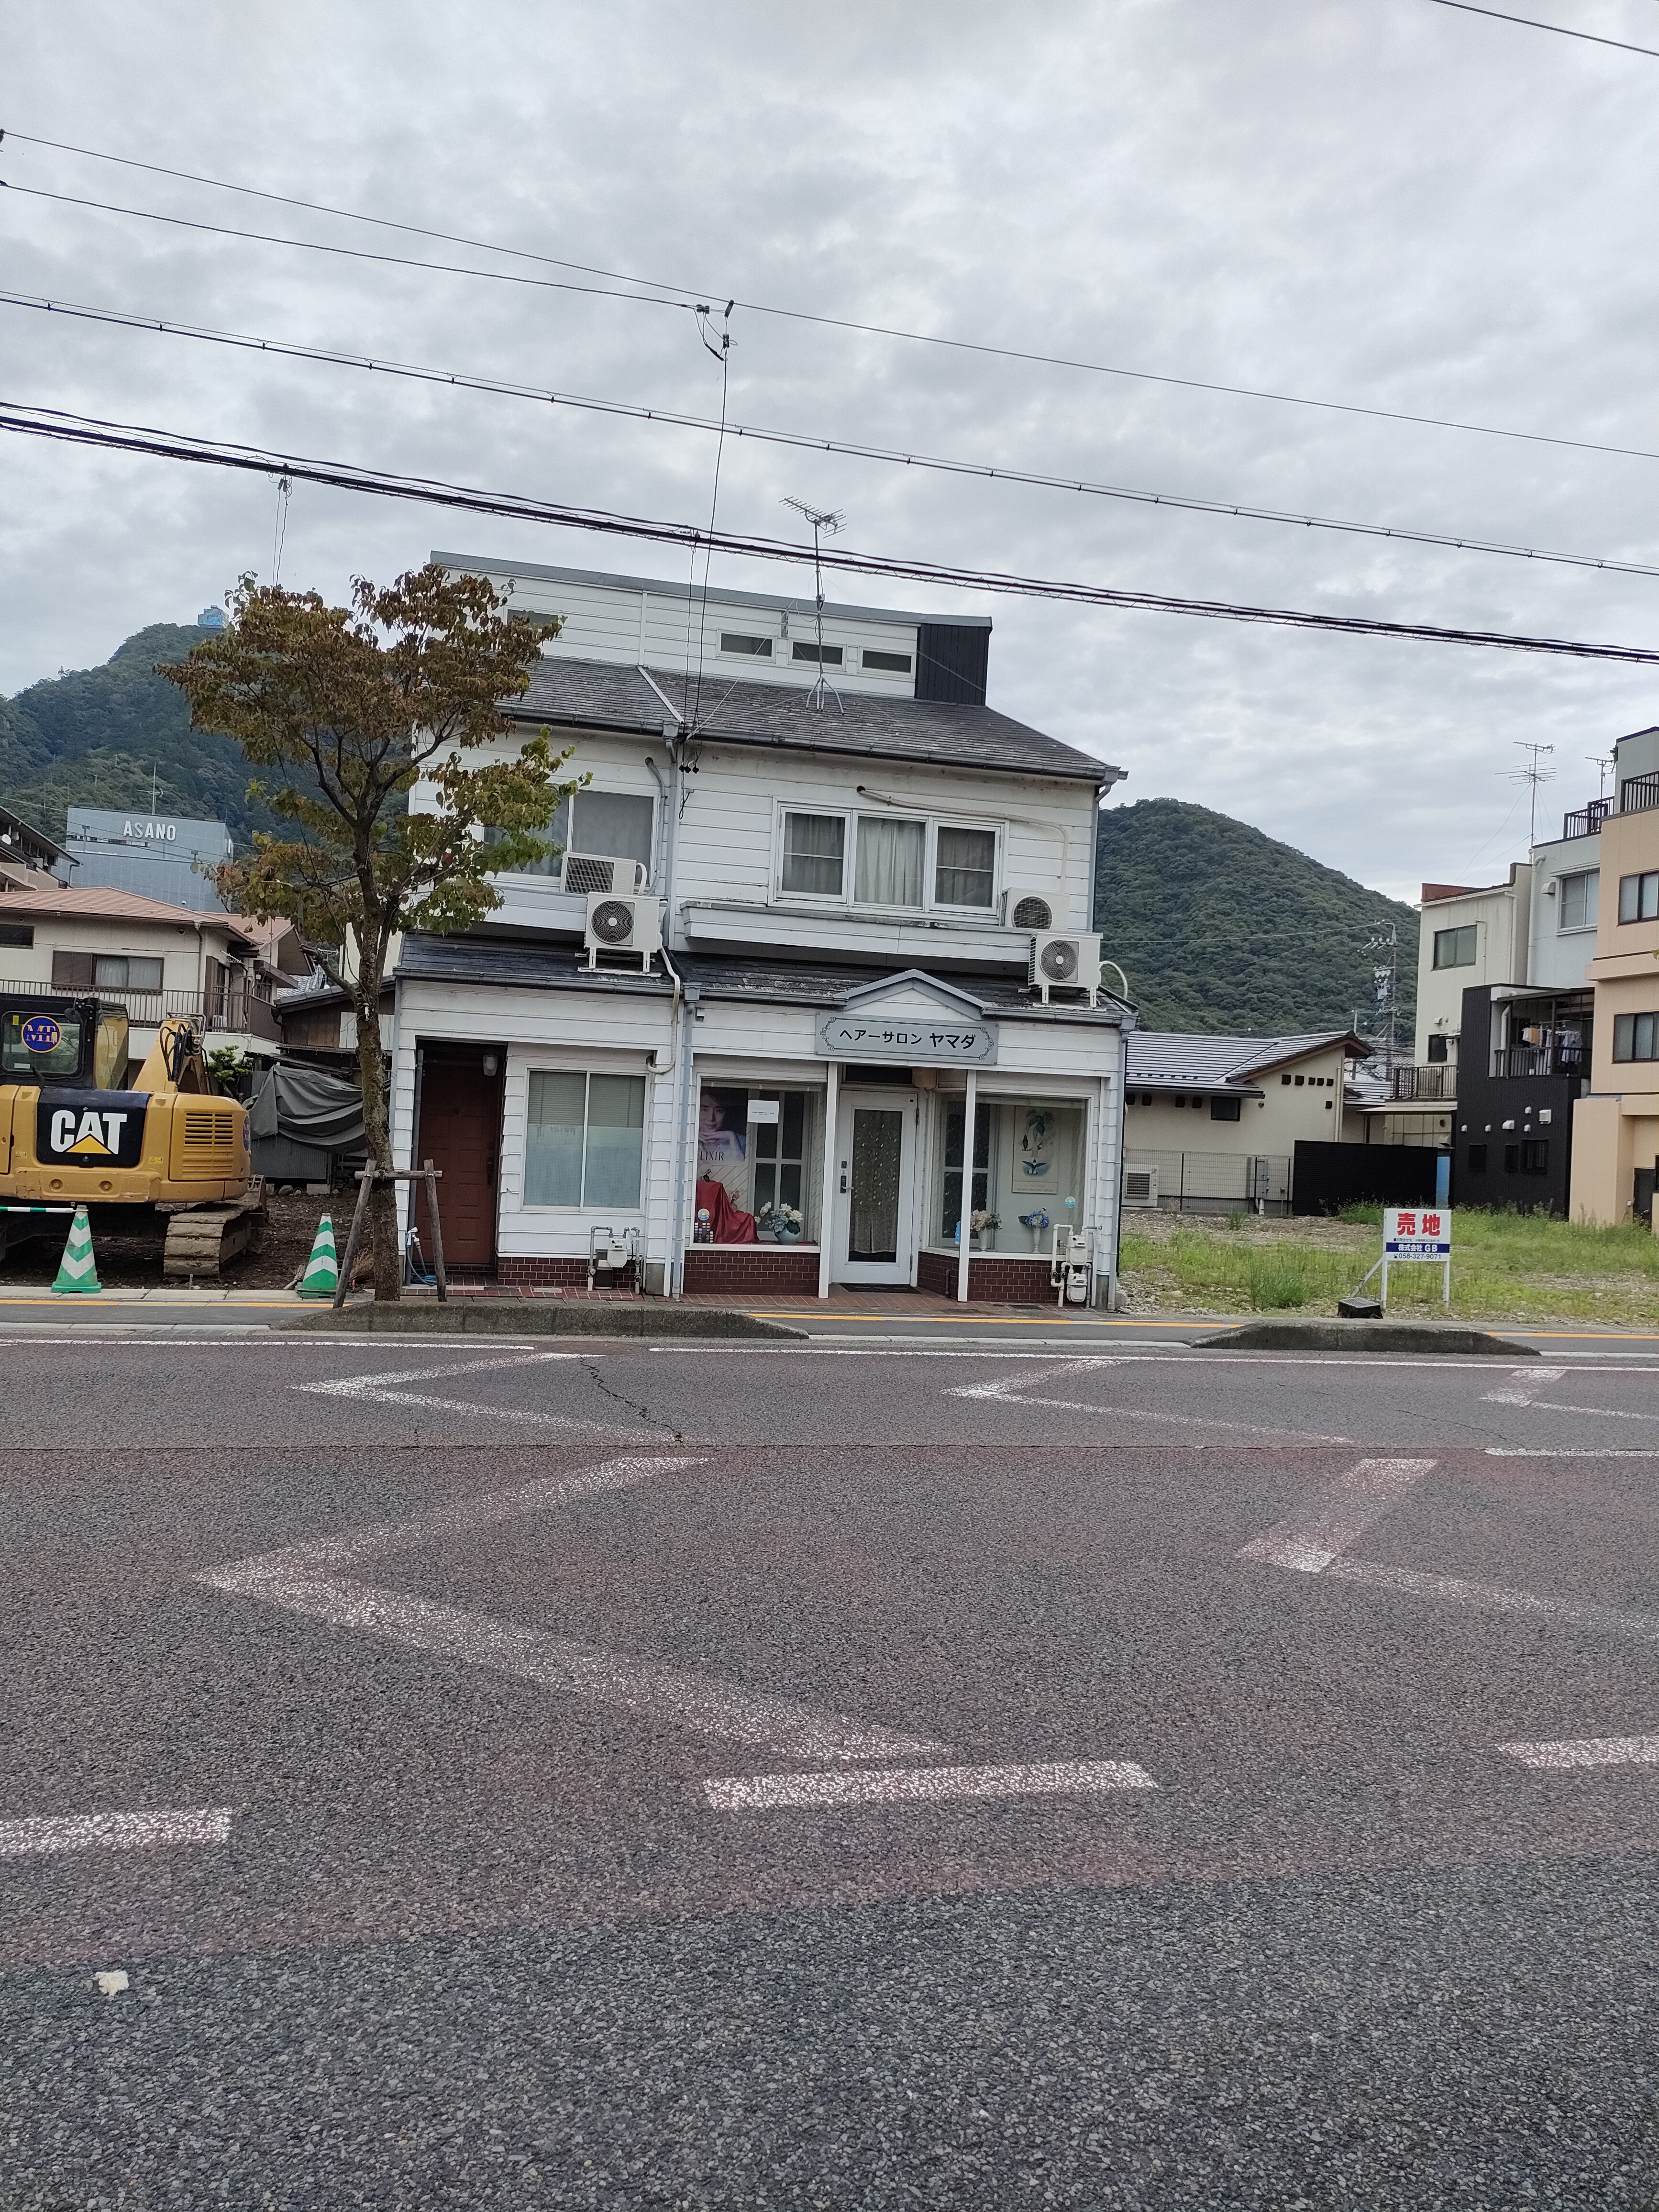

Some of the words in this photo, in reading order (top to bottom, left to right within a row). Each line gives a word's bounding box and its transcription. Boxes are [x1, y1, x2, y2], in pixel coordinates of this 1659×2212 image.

[123, 821, 176, 841] ASANO
[840, 1029, 922, 1045] ヘアーサロン
[929, 1032, 976, 1050] ヤマダ
[51, 1110, 127, 1154] CAT
[1397, 1213, 1440, 1236] 売地
[1398, 1244, 1423, 1252] 株式会社
[1424, 1244, 1438, 1252] GB
